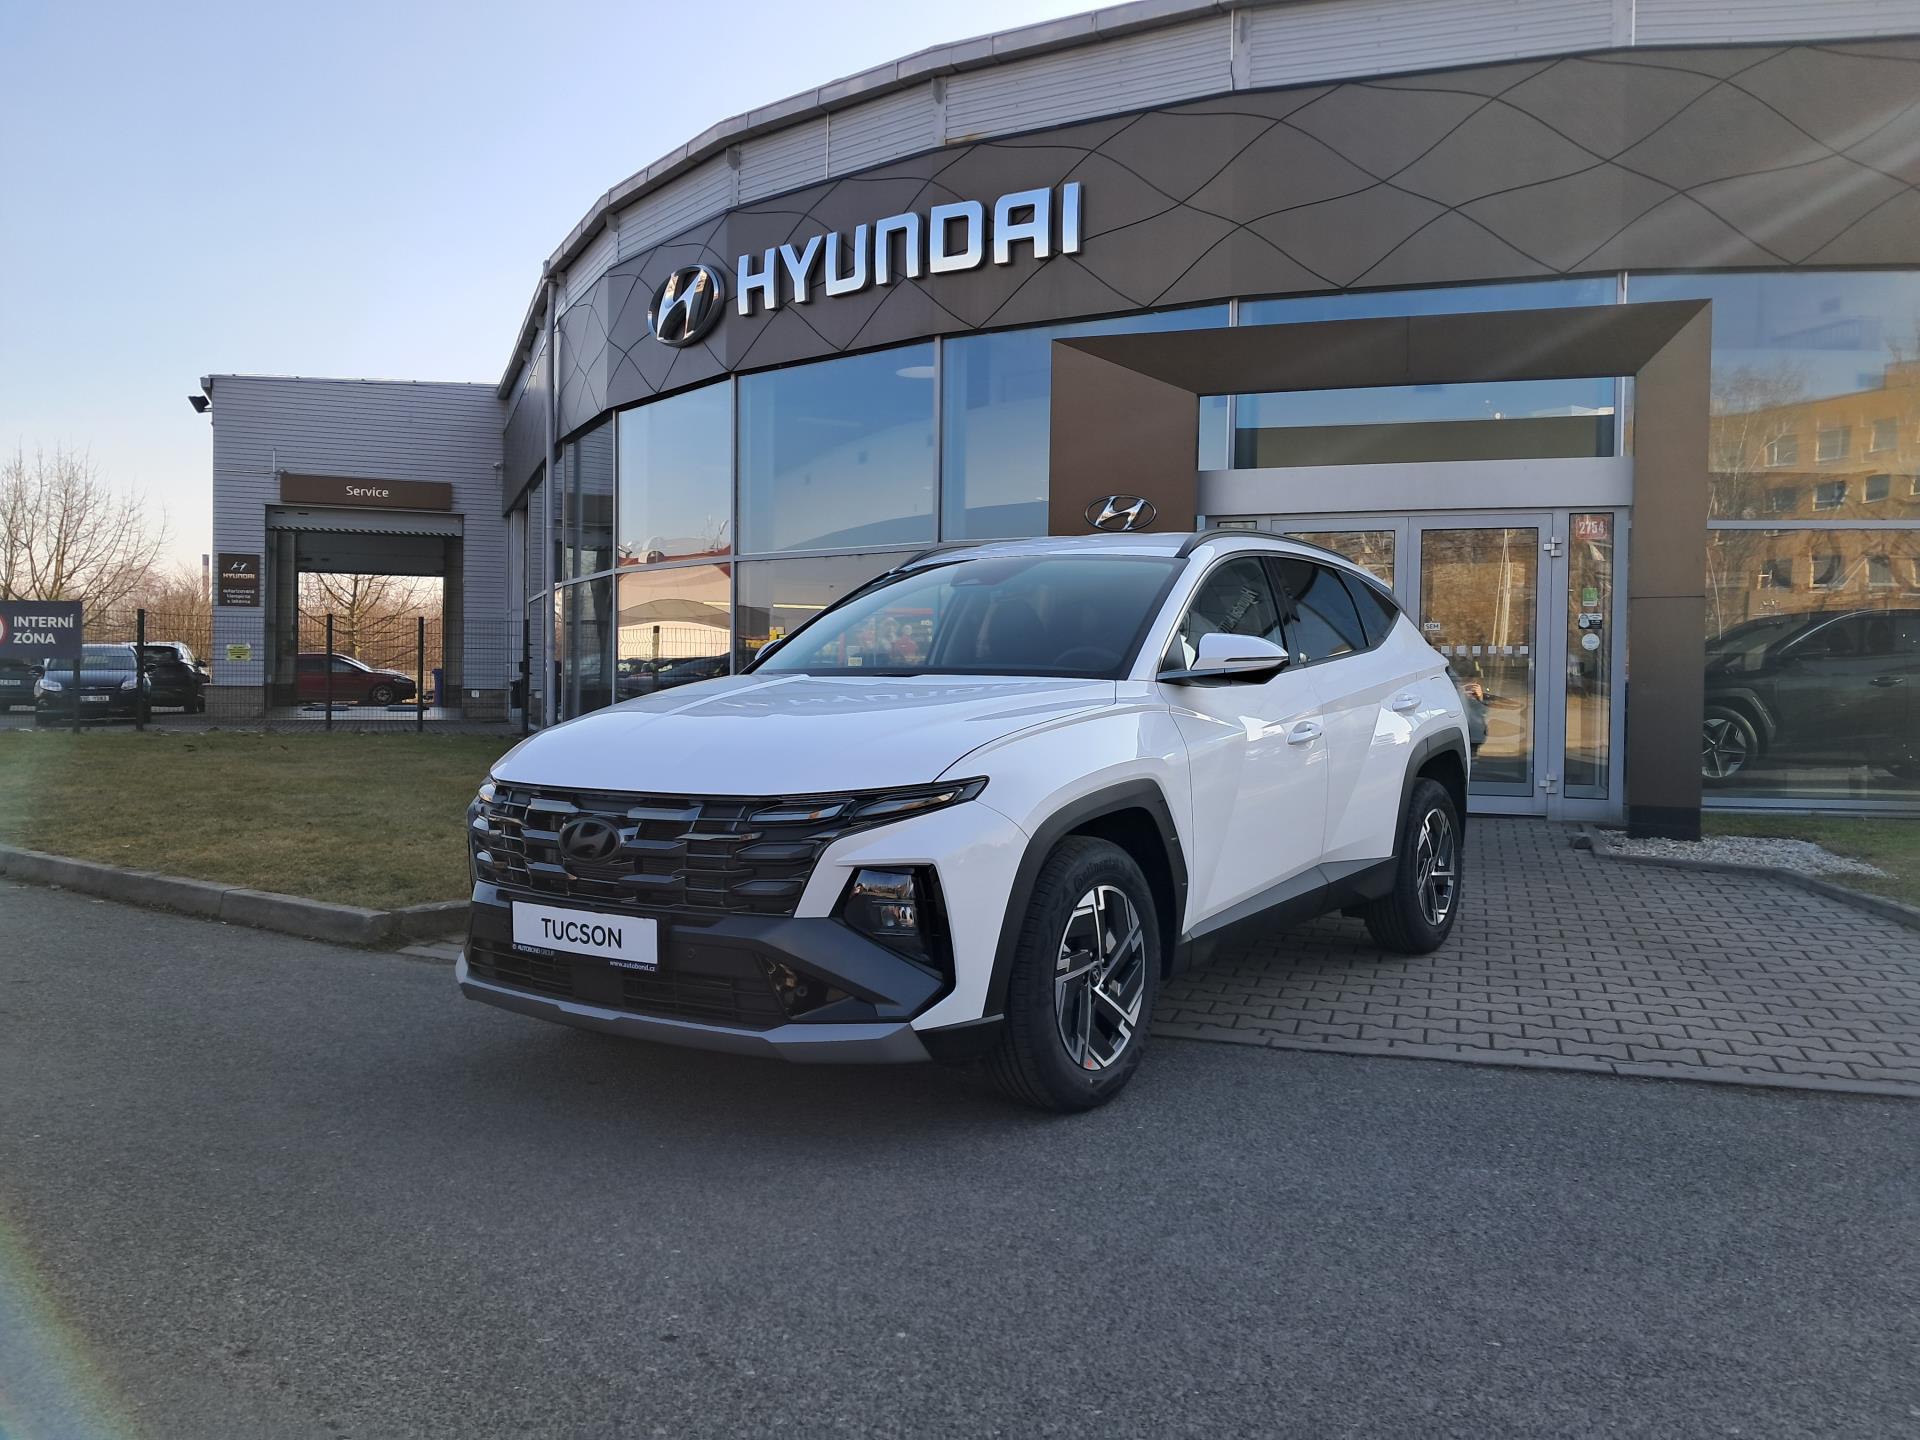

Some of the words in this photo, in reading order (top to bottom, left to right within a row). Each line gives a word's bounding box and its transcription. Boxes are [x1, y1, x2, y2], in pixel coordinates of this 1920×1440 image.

[738, 181, 1082, 316] HYUNDAI
[345, 485, 389, 498] Service
[1580, 520, 1605, 535] 2754
[13, 614, 75, 628] INTERNÍ
[13, 629, 57, 645] ZÓNA
[541, 917, 622, 949] TUCSON
